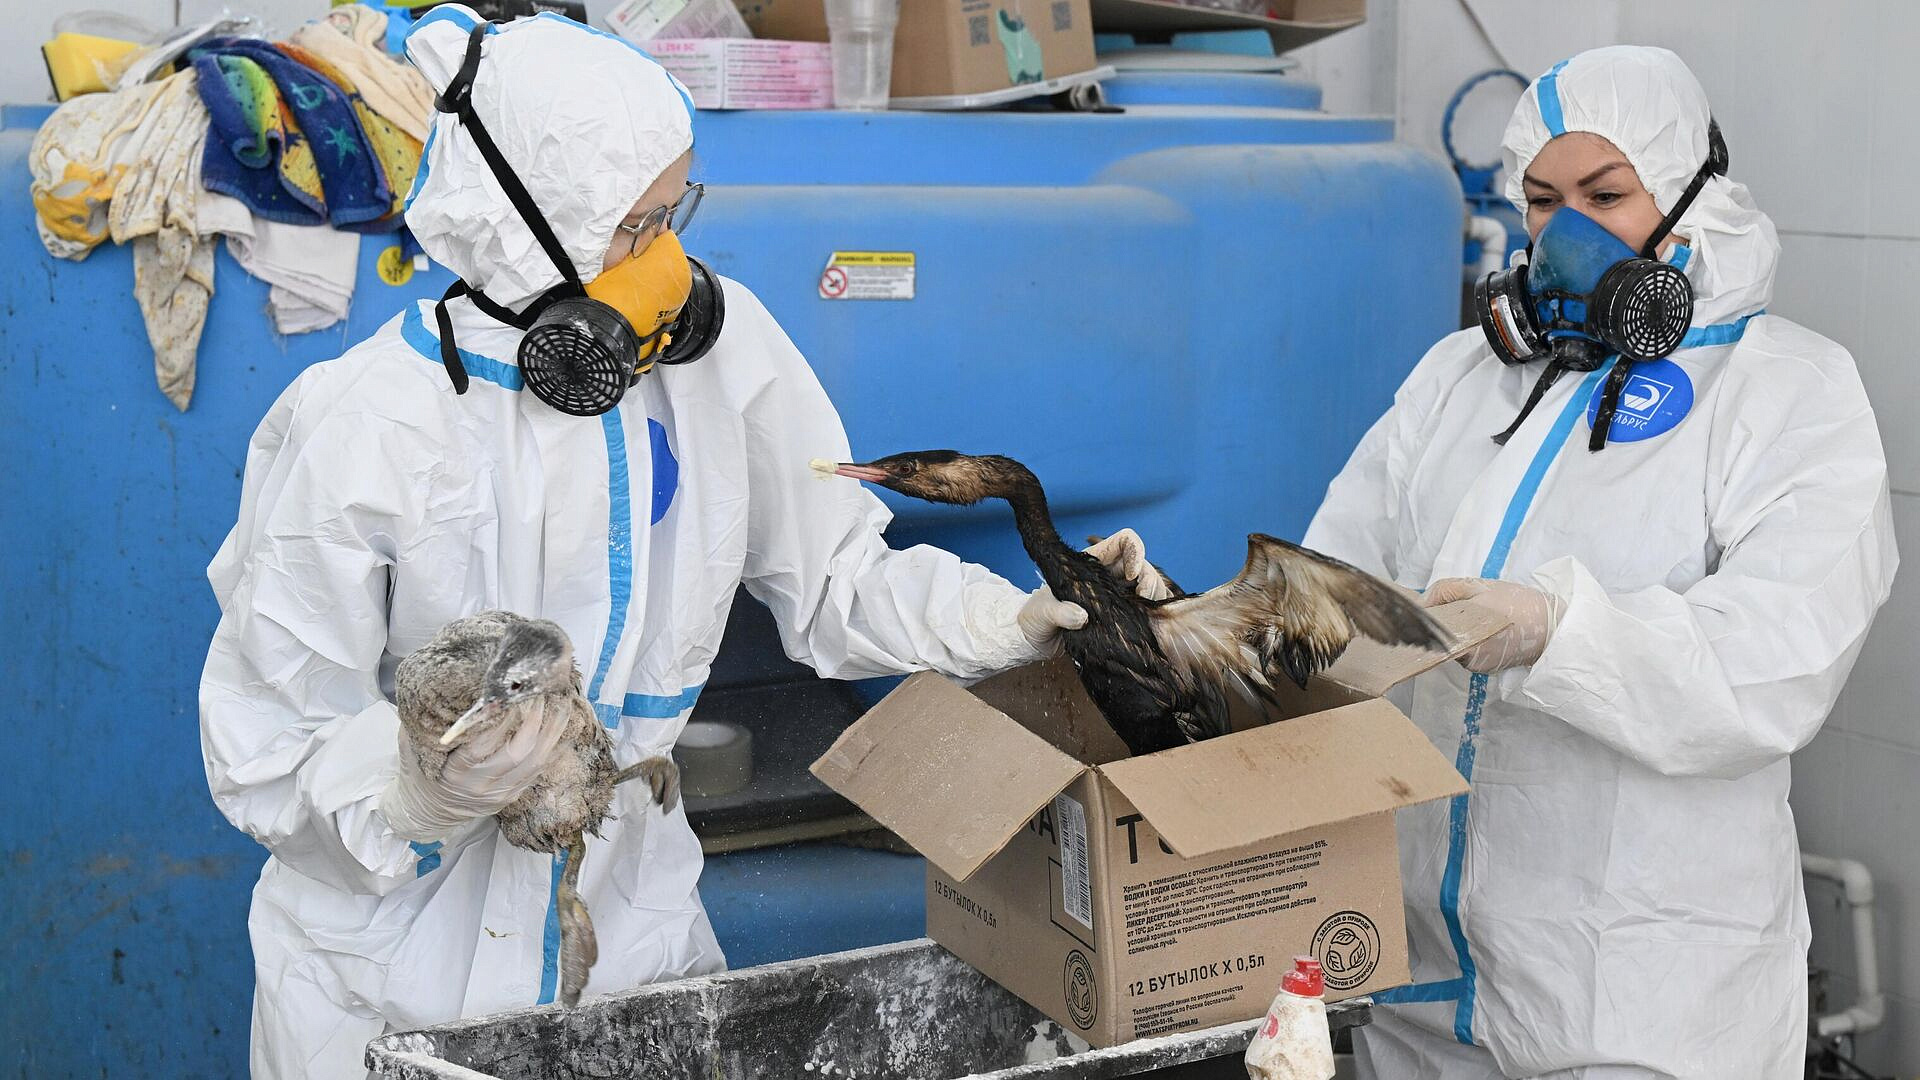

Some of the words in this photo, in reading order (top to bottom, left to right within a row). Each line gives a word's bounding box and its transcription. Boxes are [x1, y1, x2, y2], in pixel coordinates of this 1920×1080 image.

[934, 880, 942, 894] 12
[944, 885, 976, 916] БУТЫЛОК
[1320, 917, 1341, 937] ЗАБОТОЙ
[1348, 916, 1370, 930] ПРИРОДЕ
[1128, 981, 1144, 997] 12
[1148, 962, 1218, 992] БУТЫЛОК
[1236, 955, 1264, 972] 0,5л
